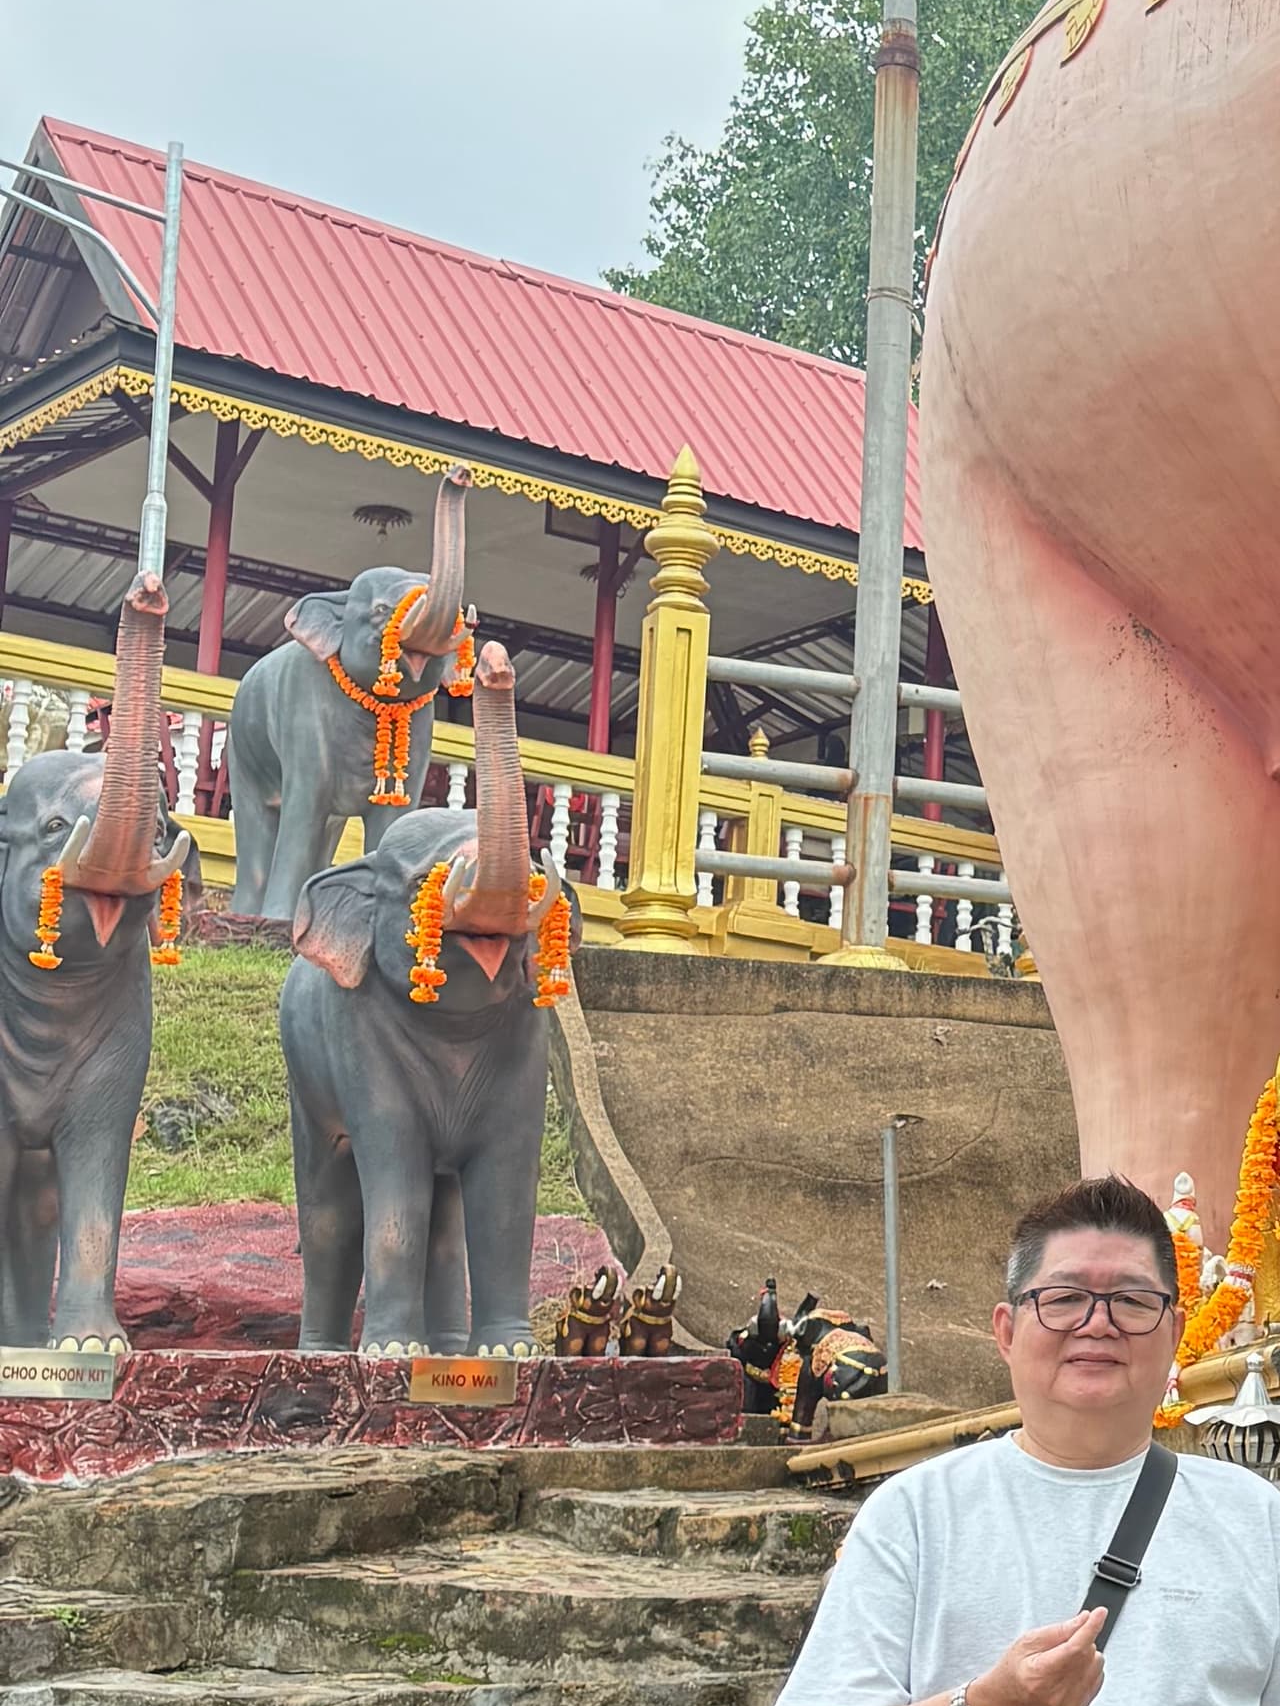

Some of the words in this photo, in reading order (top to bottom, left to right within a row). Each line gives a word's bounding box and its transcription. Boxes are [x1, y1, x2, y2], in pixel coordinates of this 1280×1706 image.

[2, 1366, 37, 1381] CHOO
[41, 1367, 84, 1381] CHOON
[88, 1369, 106, 1382] KIT
[472, 1375, 498, 1387] WAI
